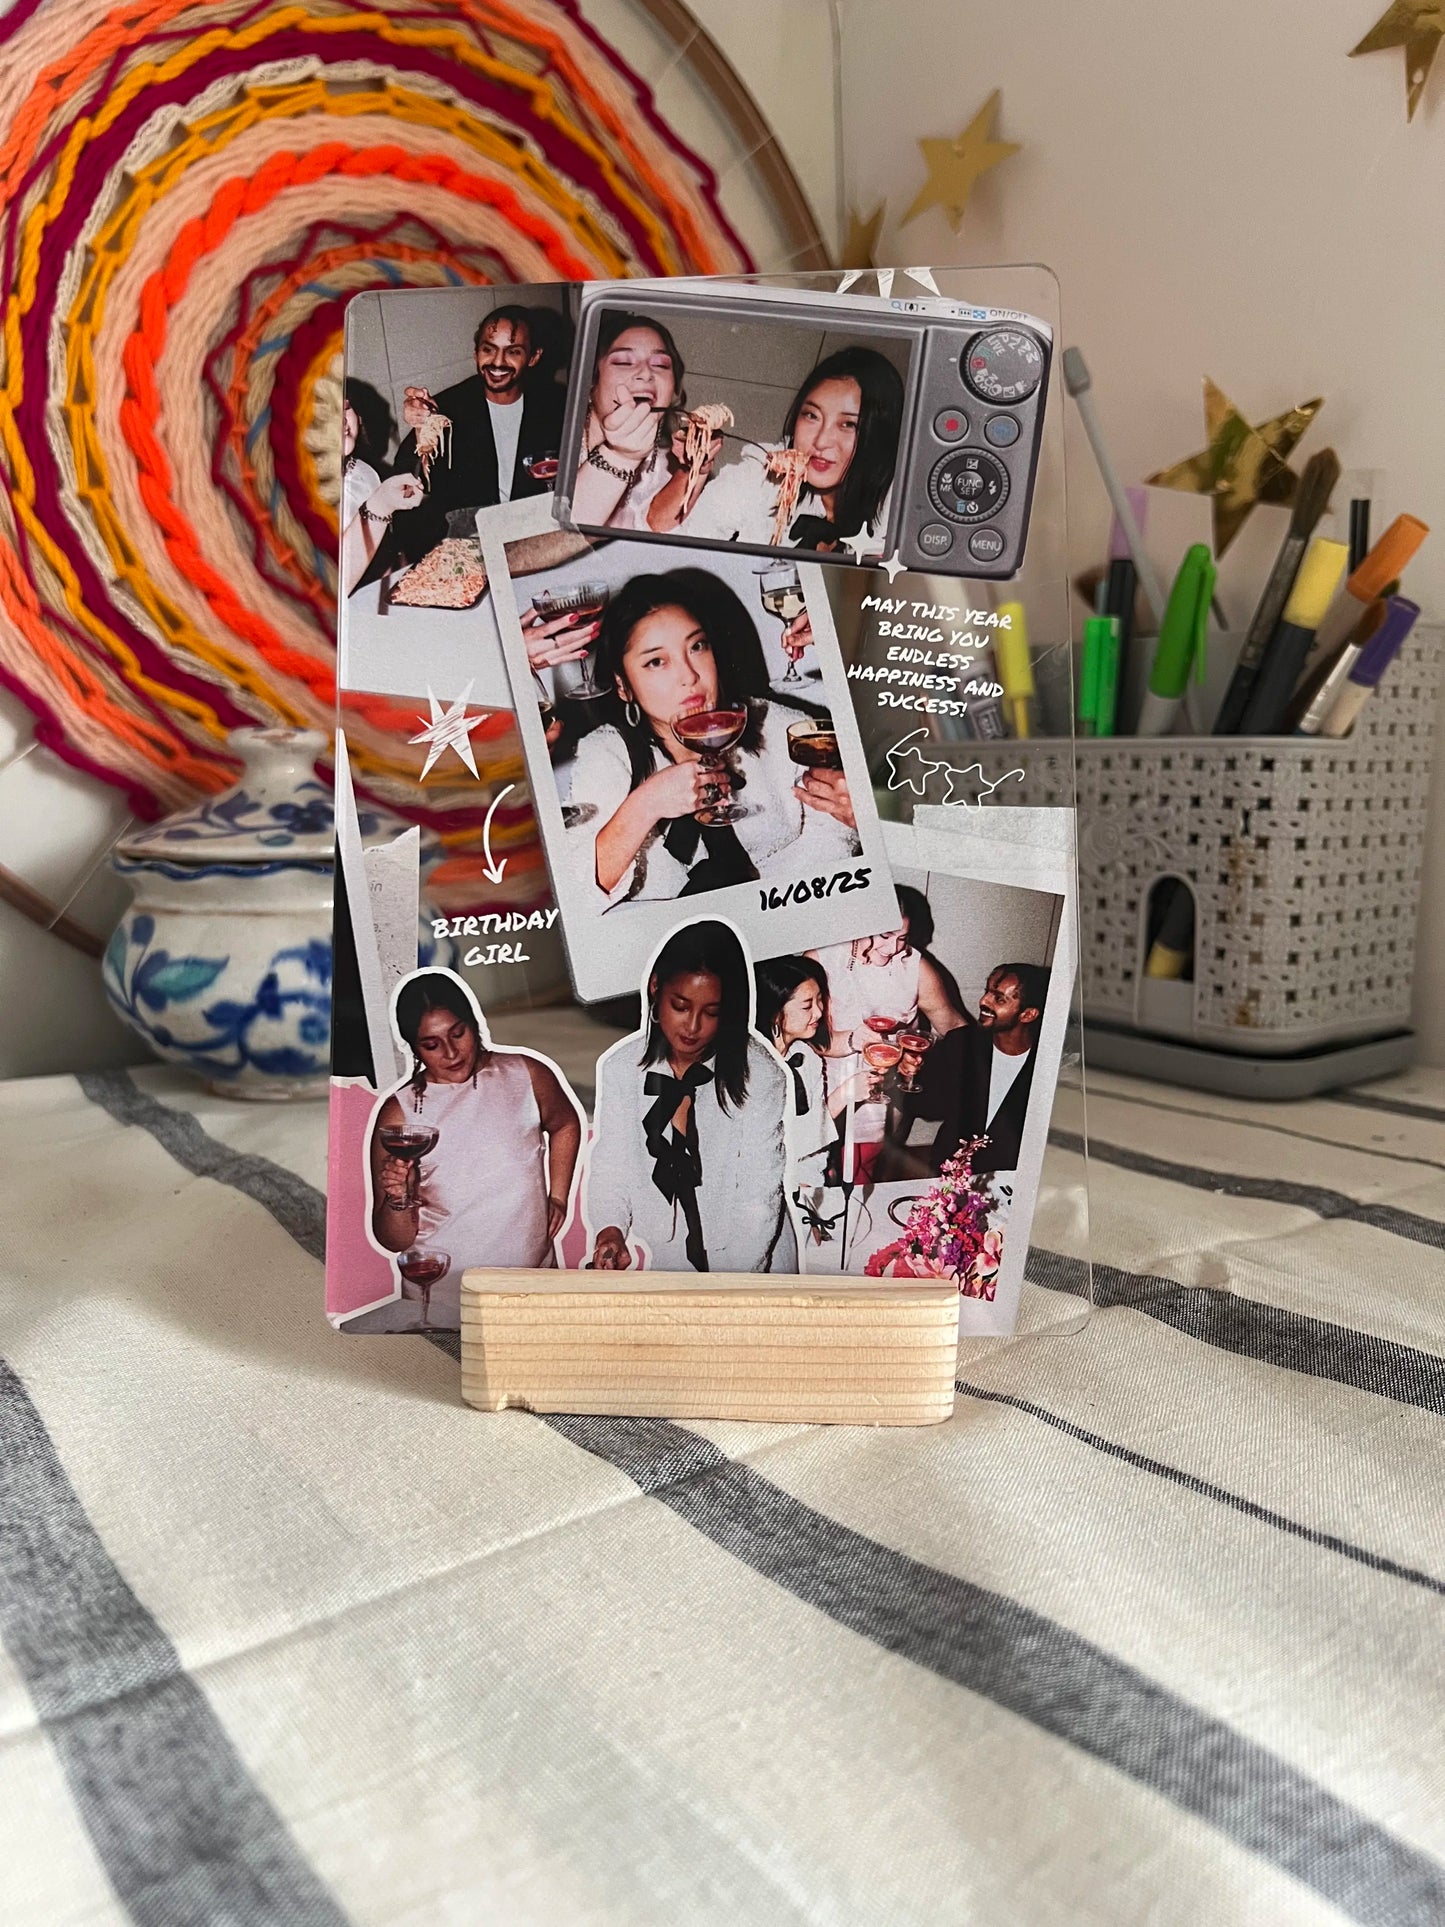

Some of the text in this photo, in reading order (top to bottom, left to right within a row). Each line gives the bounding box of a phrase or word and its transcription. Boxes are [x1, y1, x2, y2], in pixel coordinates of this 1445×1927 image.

[987, 335, 1006, 357] LIVE
[960, 487, 977, 496] SET
[971, 539, 1001, 552] MENU
[861, 595, 1012, 630] MAY THIS YEAR
[878, 621, 989, 649] BRING YOU
[887, 646, 974, 671] ENDLESS
[847, 664, 1004, 698] HAPPINESS AND
[878, 691, 968, 718] SUCCESS!
[759, 867, 872, 911] 16/08/25
[430, 908, 560, 940] BIRTHDAY
[463, 942, 531, 967] GIRL
